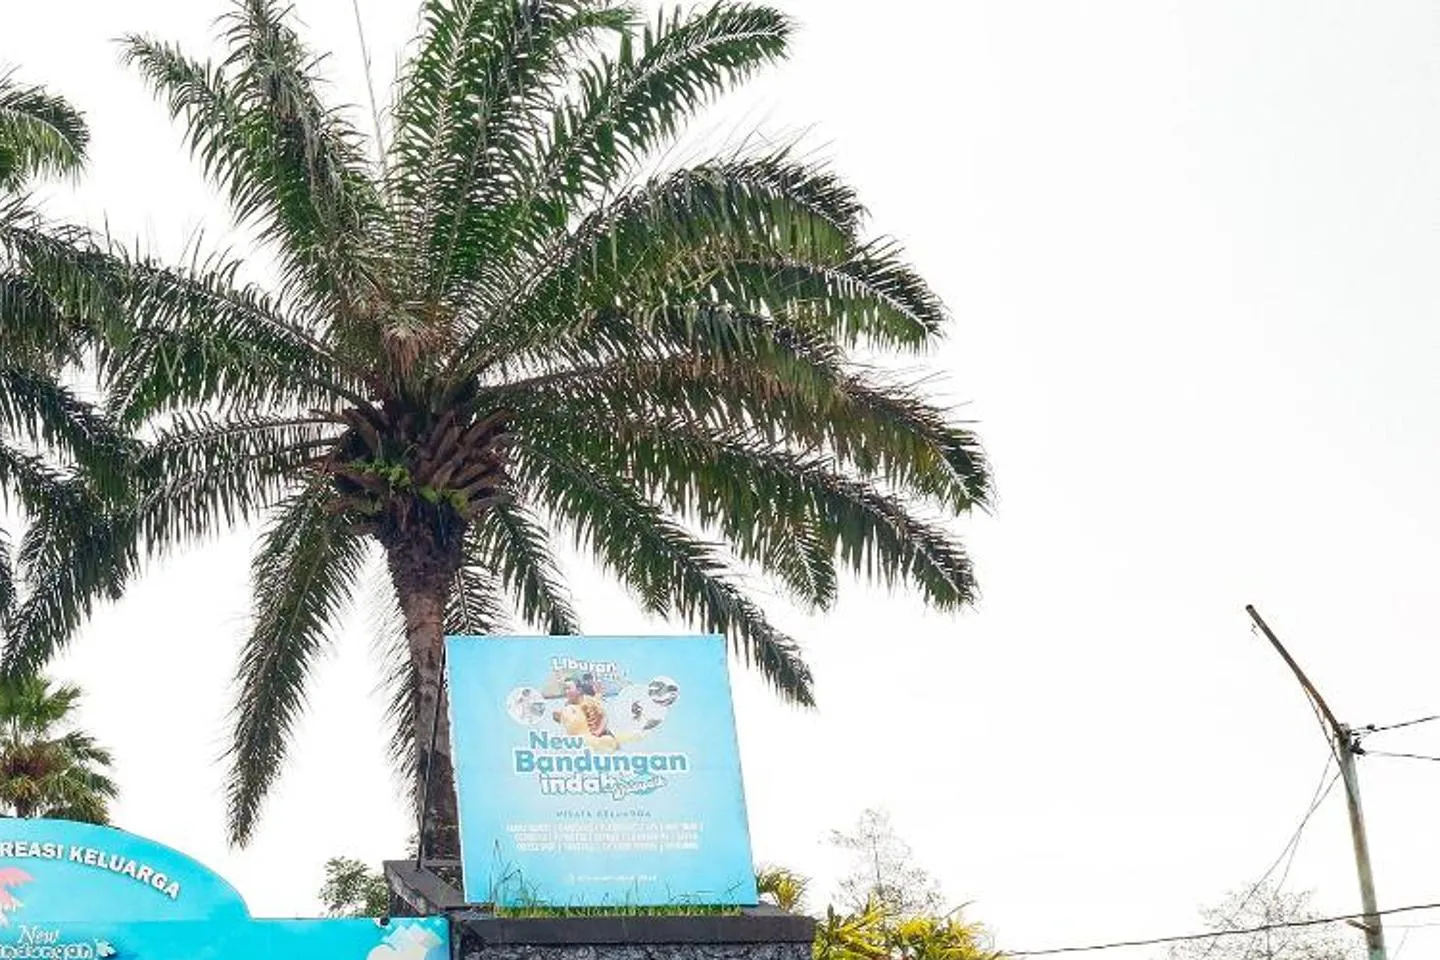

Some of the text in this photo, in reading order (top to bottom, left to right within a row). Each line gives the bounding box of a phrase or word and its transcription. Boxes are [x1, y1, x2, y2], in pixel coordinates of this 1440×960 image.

[529, 731, 585, 750] New
[514, 749, 688, 777] Bandungan
[69, 844, 181, 900] KELUARGA
[16, 924, 60, 944] New
